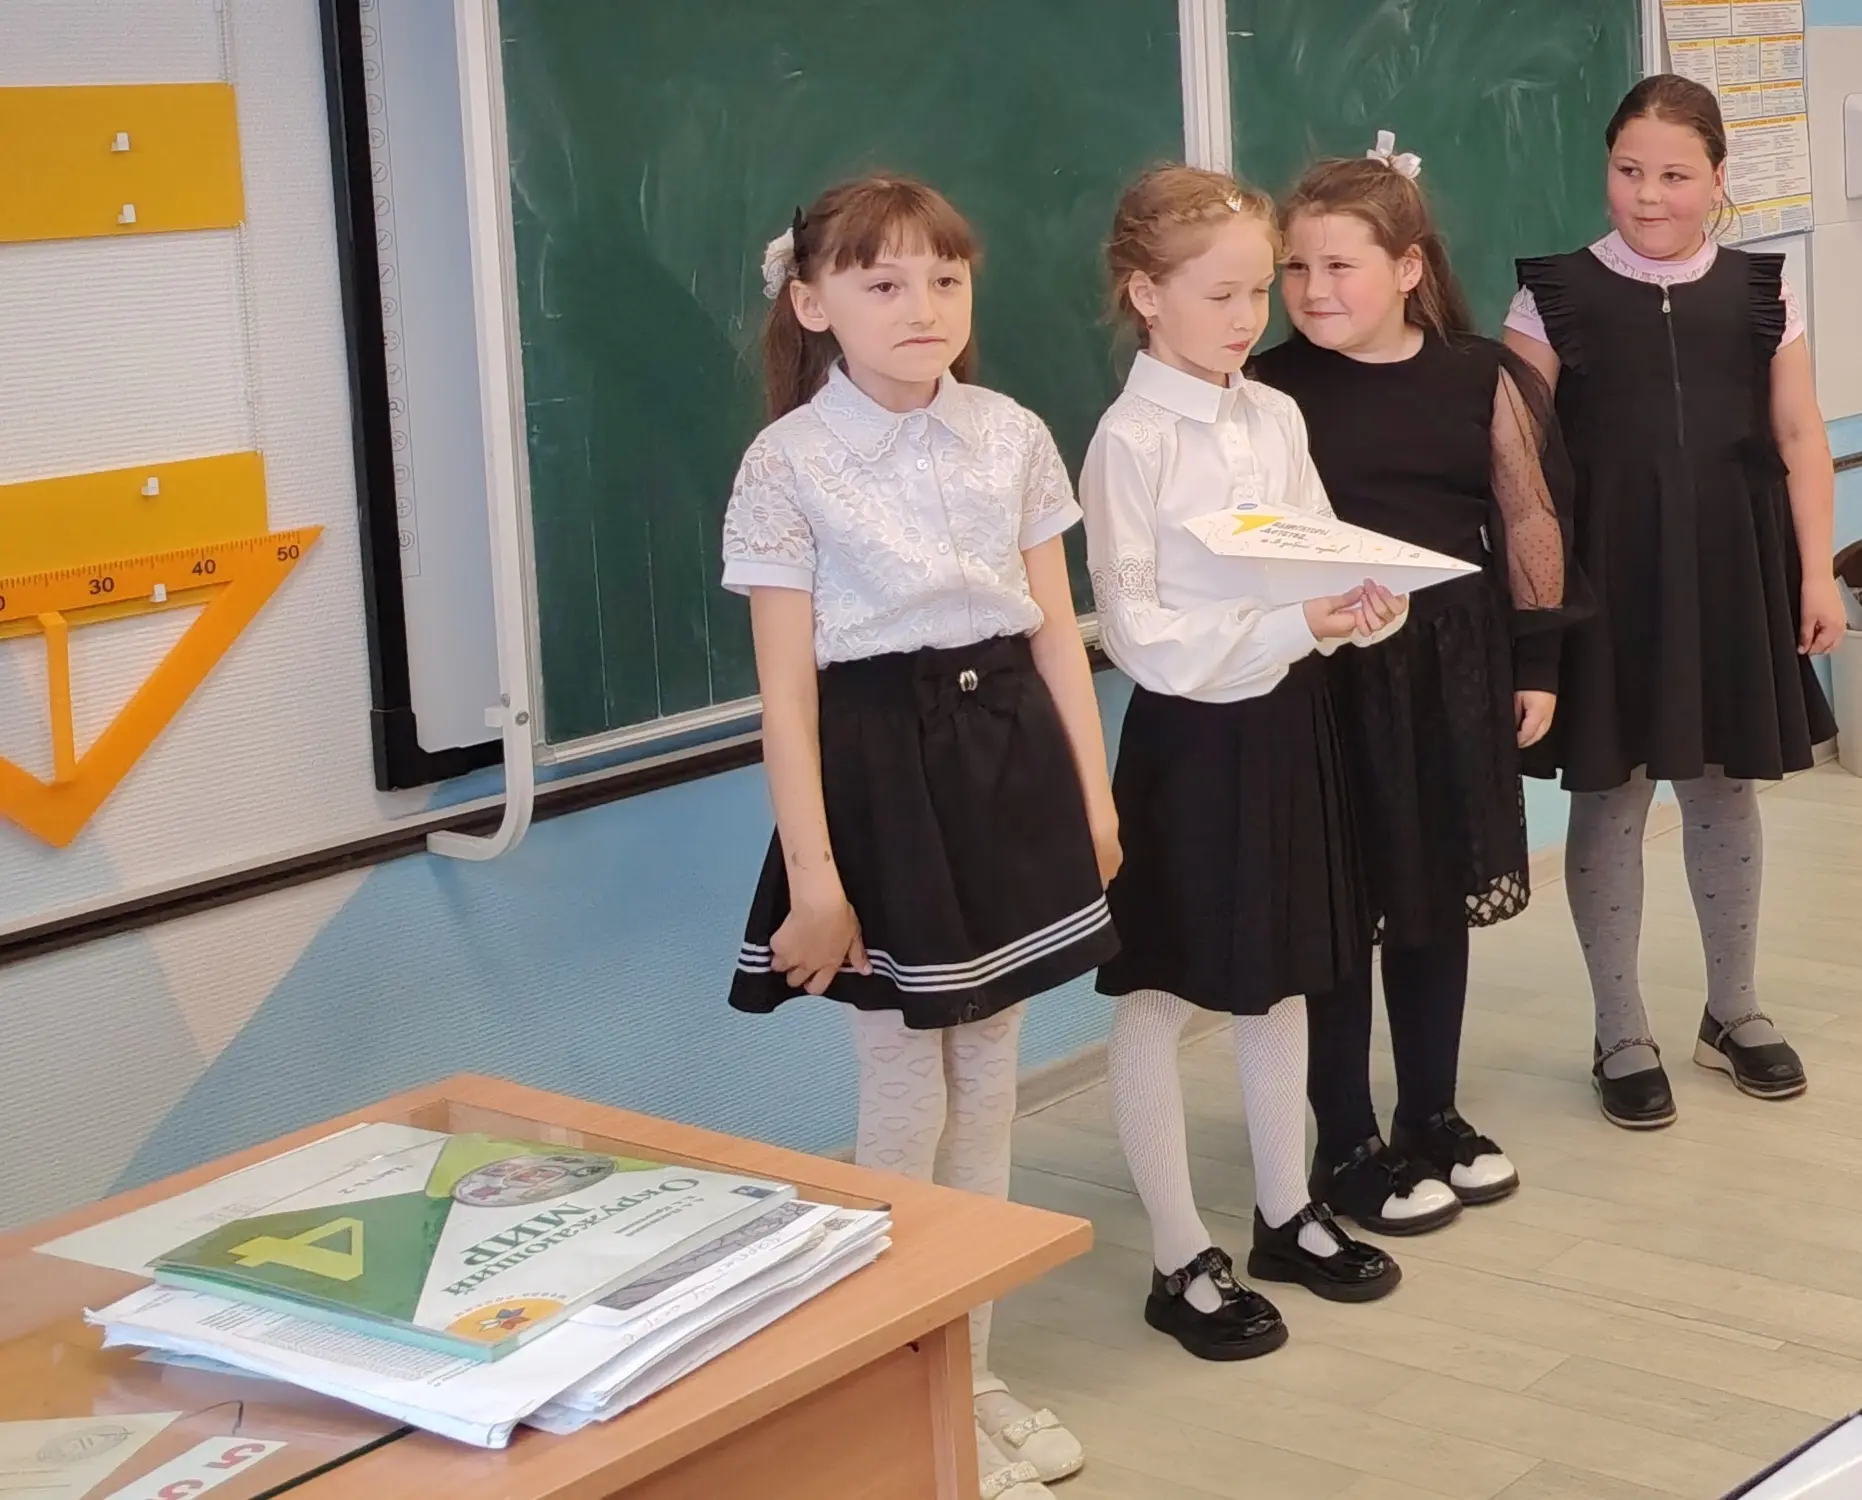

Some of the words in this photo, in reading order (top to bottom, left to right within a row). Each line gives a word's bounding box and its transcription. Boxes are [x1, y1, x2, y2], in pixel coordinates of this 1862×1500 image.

[89, 577, 115, 595] 30
[191, 559, 217, 576] 40
[277, 544, 300, 562] 50
[227, 1216, 364, 1282] 4
[442, 1178, 700, 1296] Окружающий
[460, 1201, 597, 1267] МИР
[203, 1442, 267, 1470] 5
